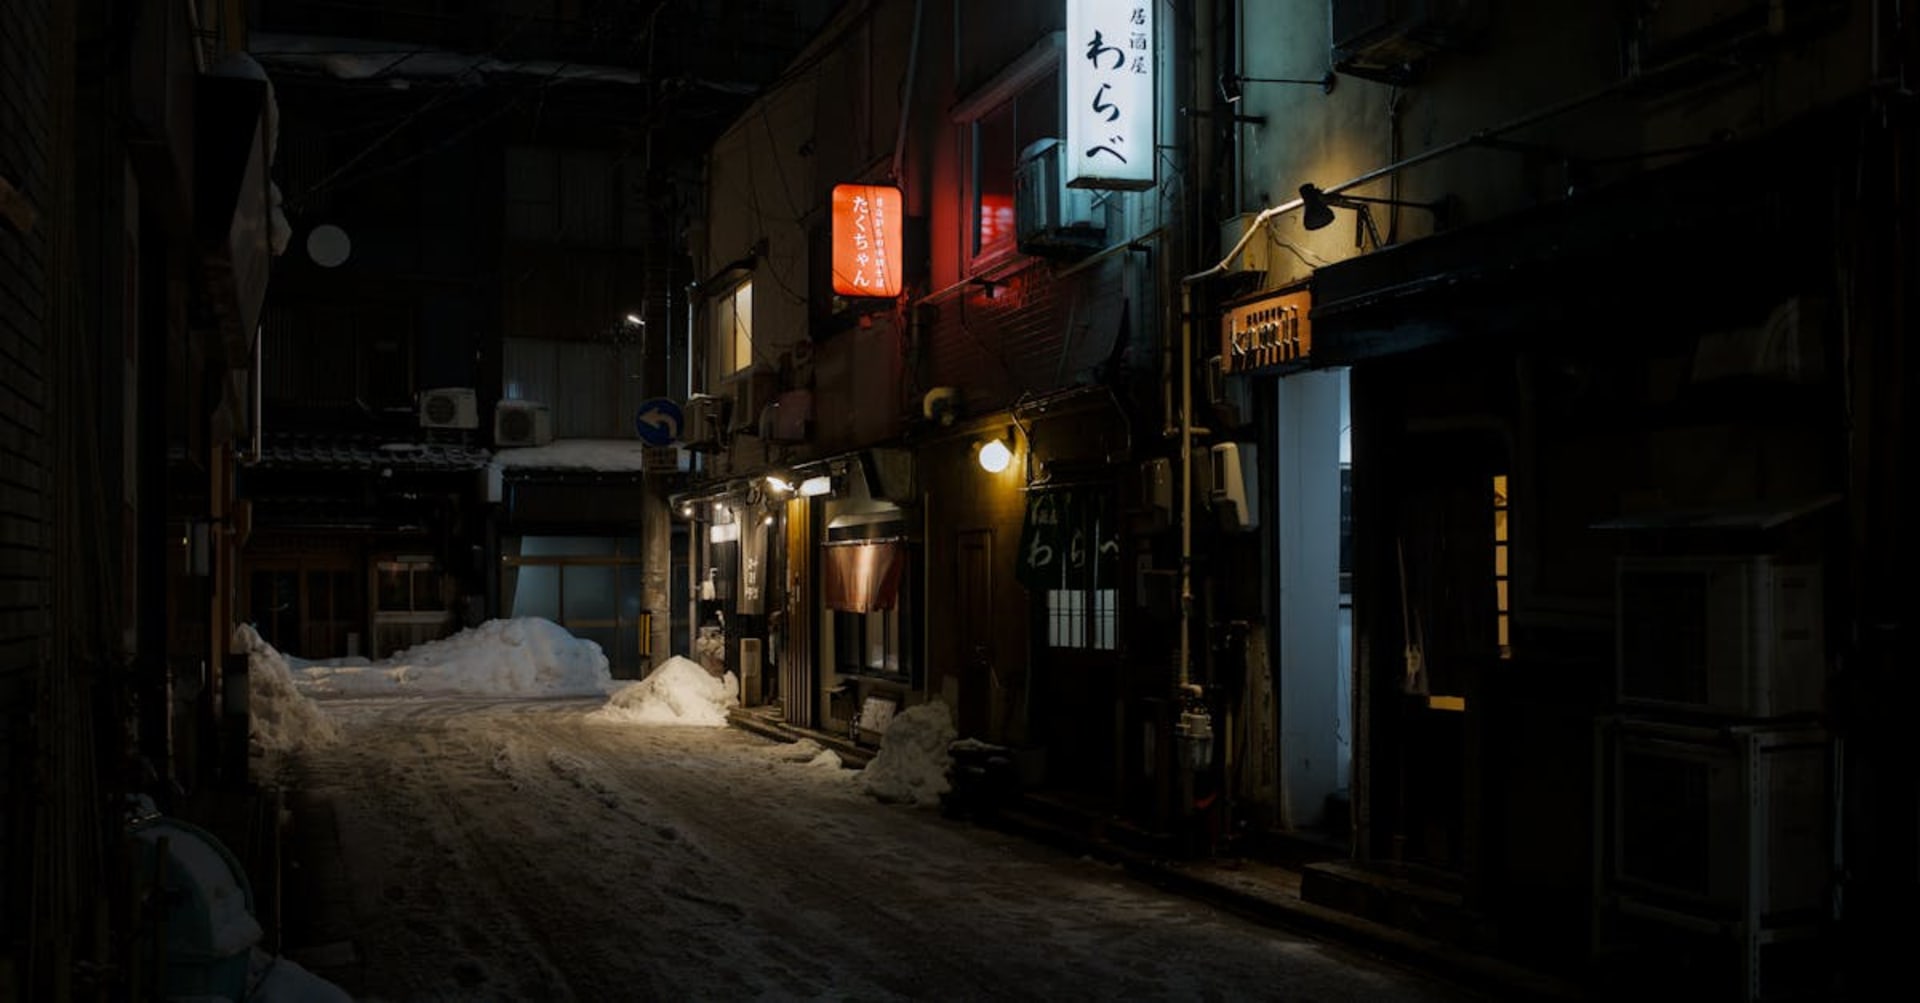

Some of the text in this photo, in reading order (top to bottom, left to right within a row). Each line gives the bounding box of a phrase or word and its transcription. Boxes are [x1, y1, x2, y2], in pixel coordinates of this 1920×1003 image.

[1130, 8, 1147, 74] 居酒屋
[1086, 29, 1128, 164] わらべ
[853, 196, 871, 288] たくちゃん
